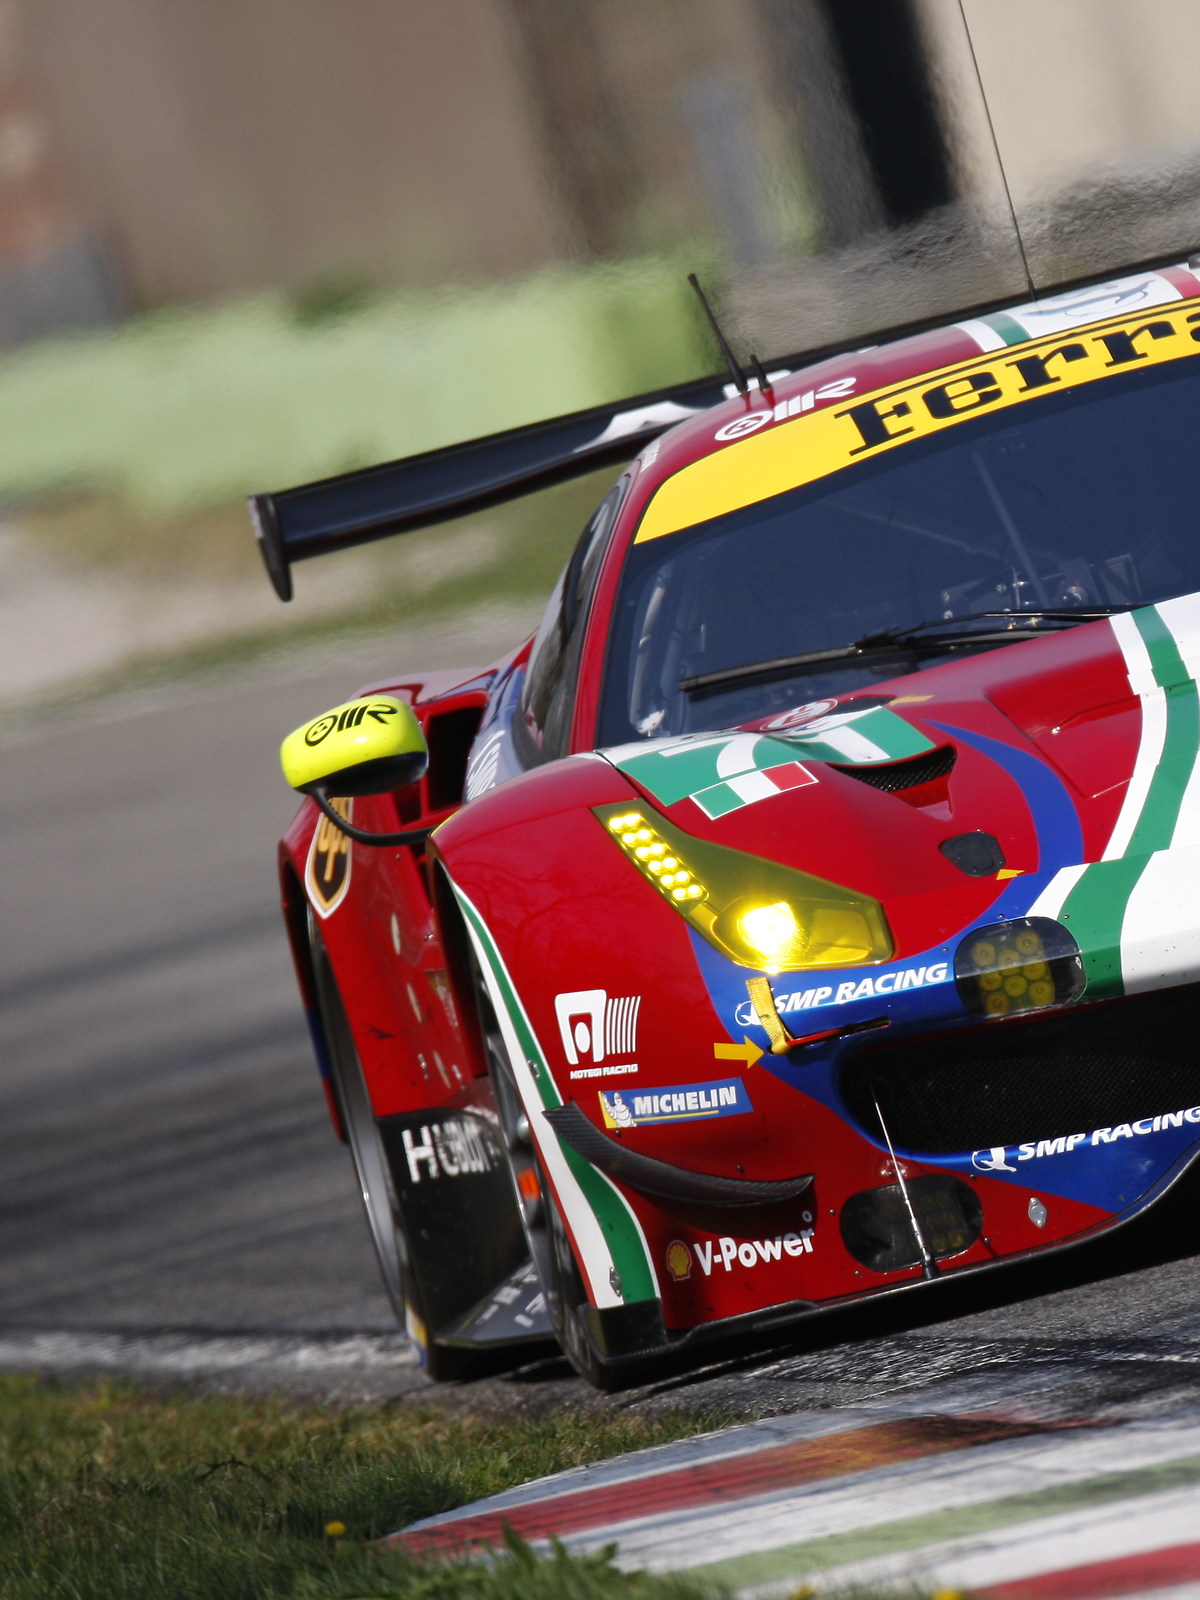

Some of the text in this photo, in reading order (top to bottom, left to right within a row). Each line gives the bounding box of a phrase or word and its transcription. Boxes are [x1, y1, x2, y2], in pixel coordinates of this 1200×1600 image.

[773, 963, 947, 1014] SMP RACING
[633, 1086, 738, 1115] MICHELIN
[1017, 1133, 1085, 1161] SMP
[693, 1230, 815, 1276] V-Power
